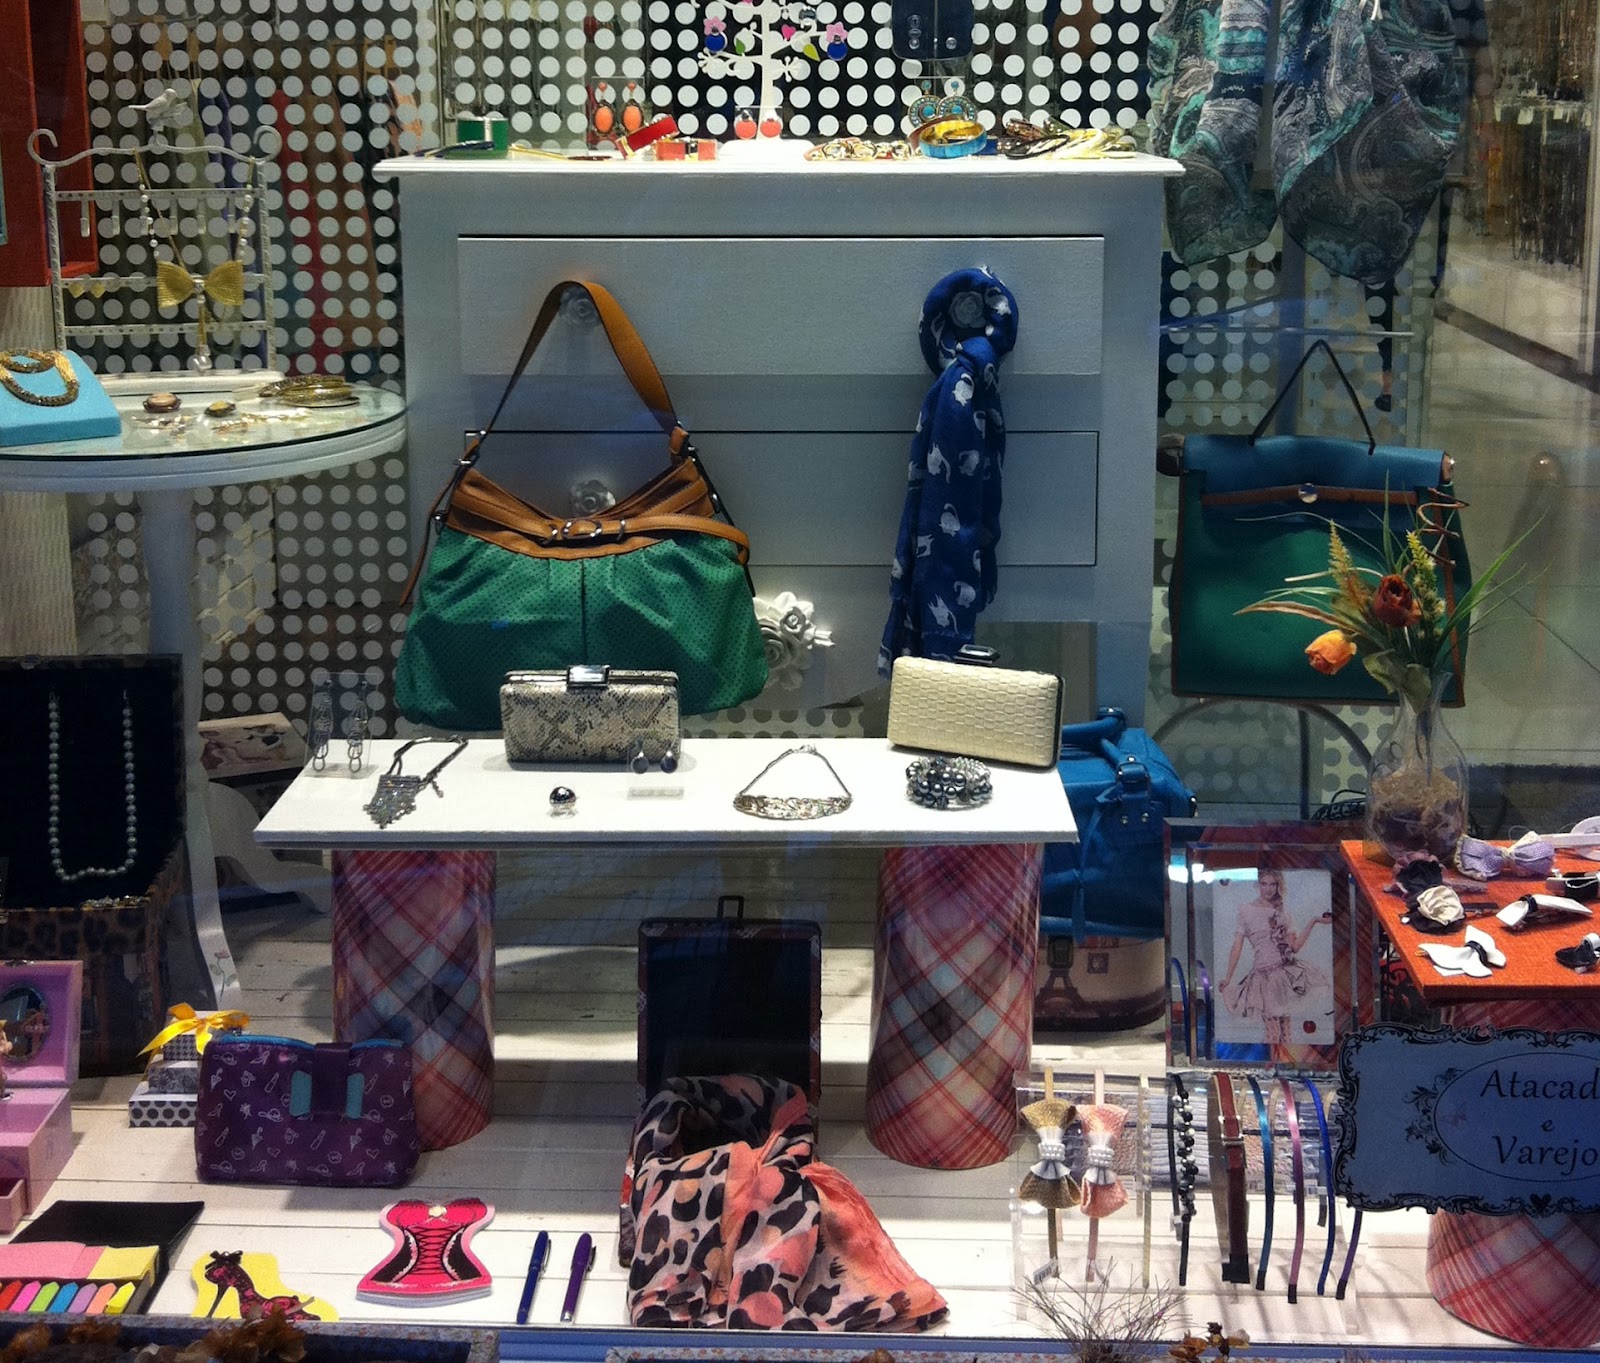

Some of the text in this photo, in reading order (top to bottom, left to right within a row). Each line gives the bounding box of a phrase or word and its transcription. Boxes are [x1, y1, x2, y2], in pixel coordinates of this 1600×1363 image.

[1480, 1067, 1600, 1100] Atacad
[1540, 1119, 1555, 1132] e
[1491, 1135, 1598, 1176] Varejo
